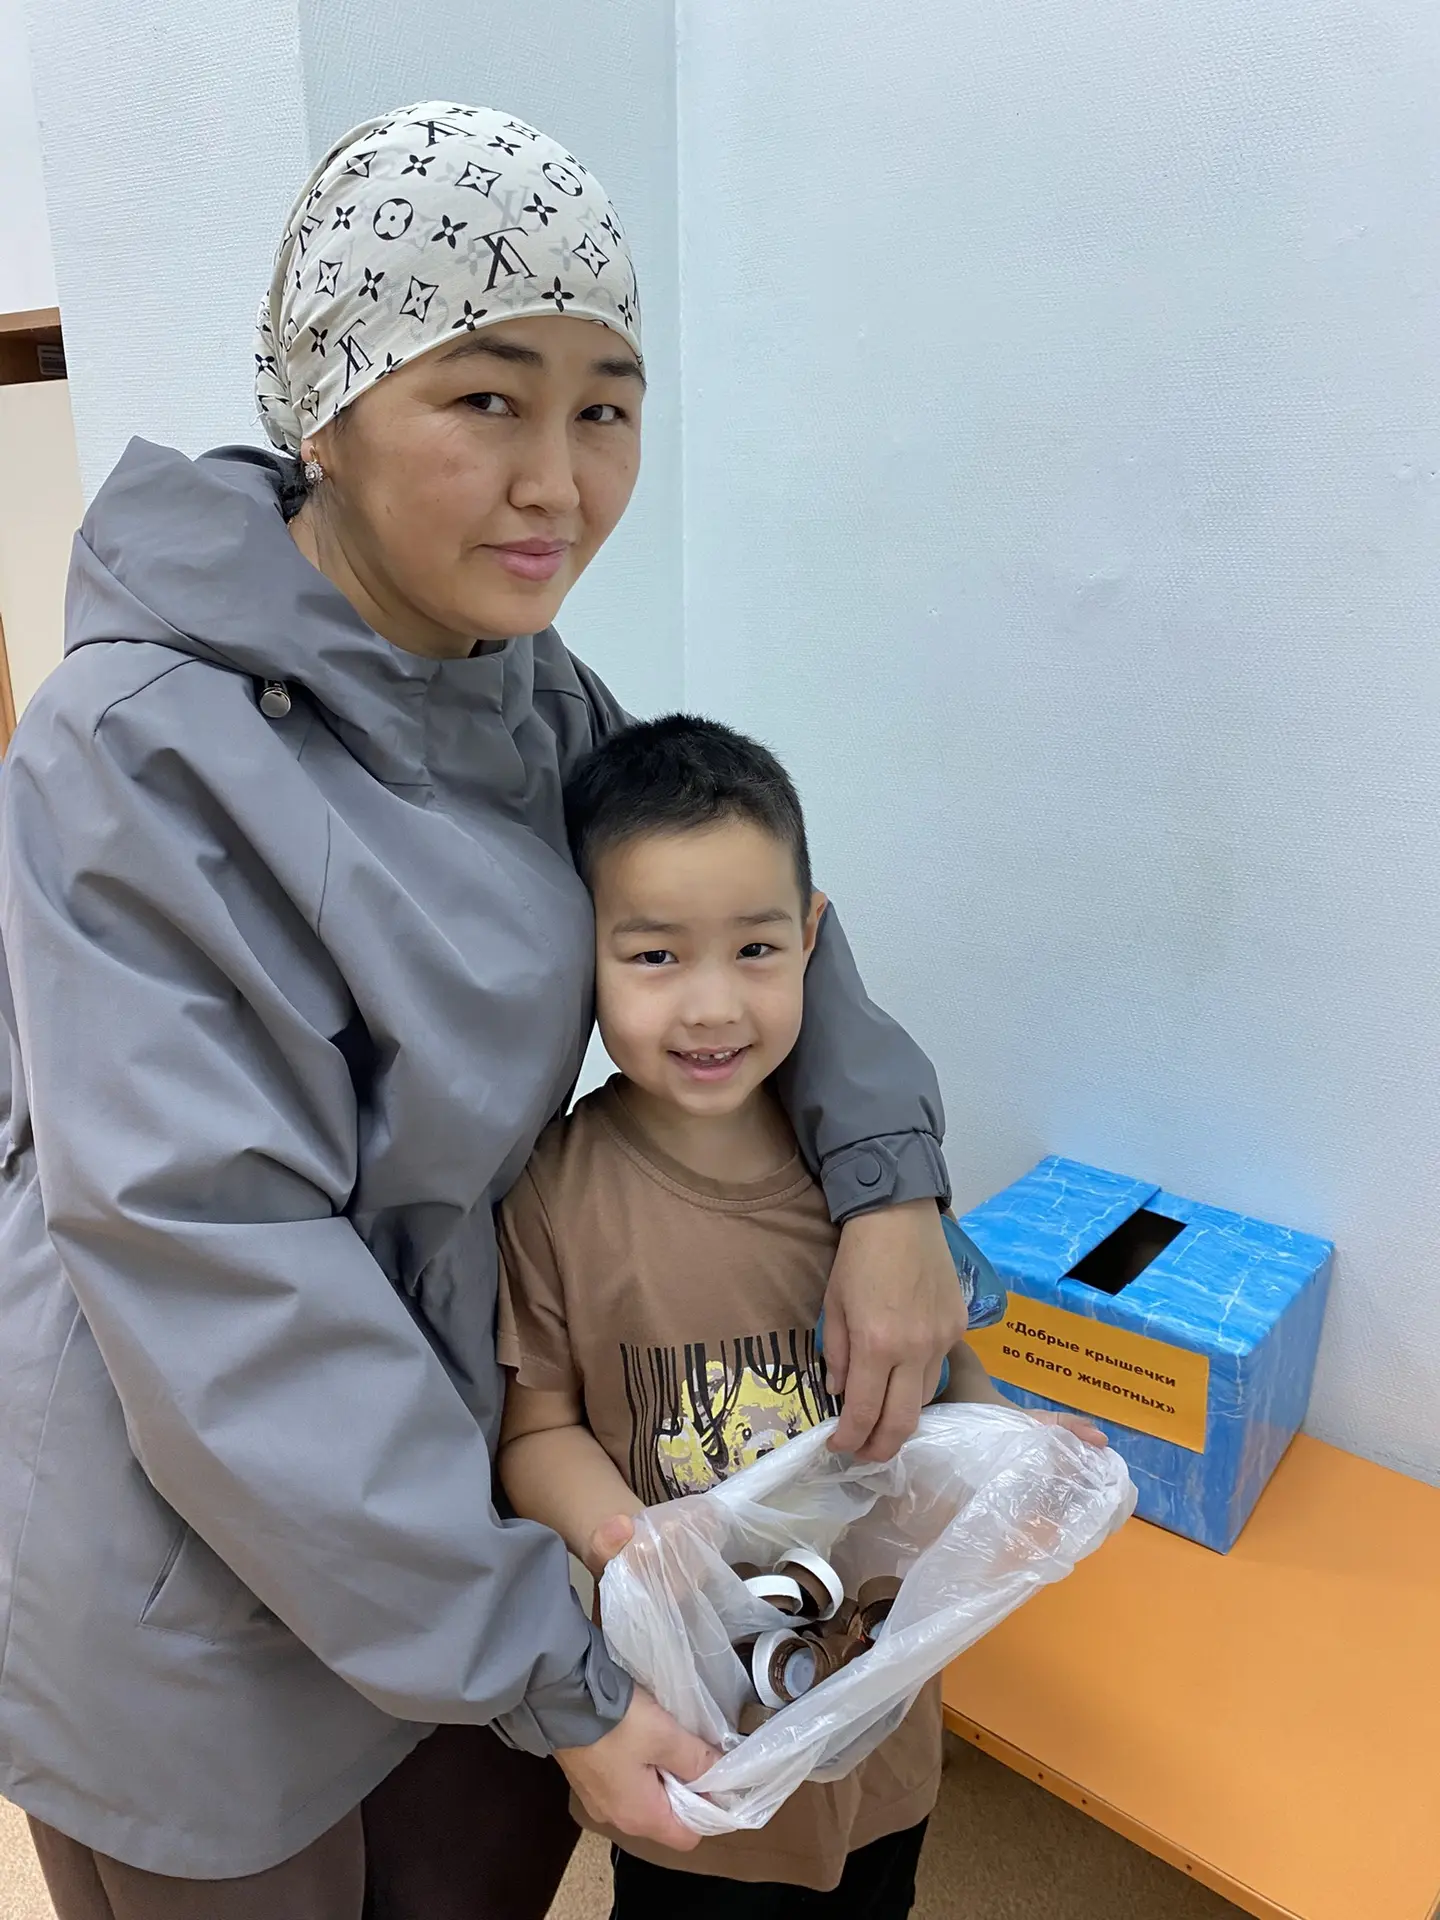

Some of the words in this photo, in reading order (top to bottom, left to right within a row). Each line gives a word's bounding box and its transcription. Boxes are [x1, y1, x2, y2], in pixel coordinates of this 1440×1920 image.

[1002, 1345, 1020, 1358] во
[1025, 1352, 1072, 1377] благо
[1077, 1371, 1176, 1415] животных»
[1006, 1321, 1080, 1353] «Добрые
[1085, 1348, 1176, 1387] крышечки
